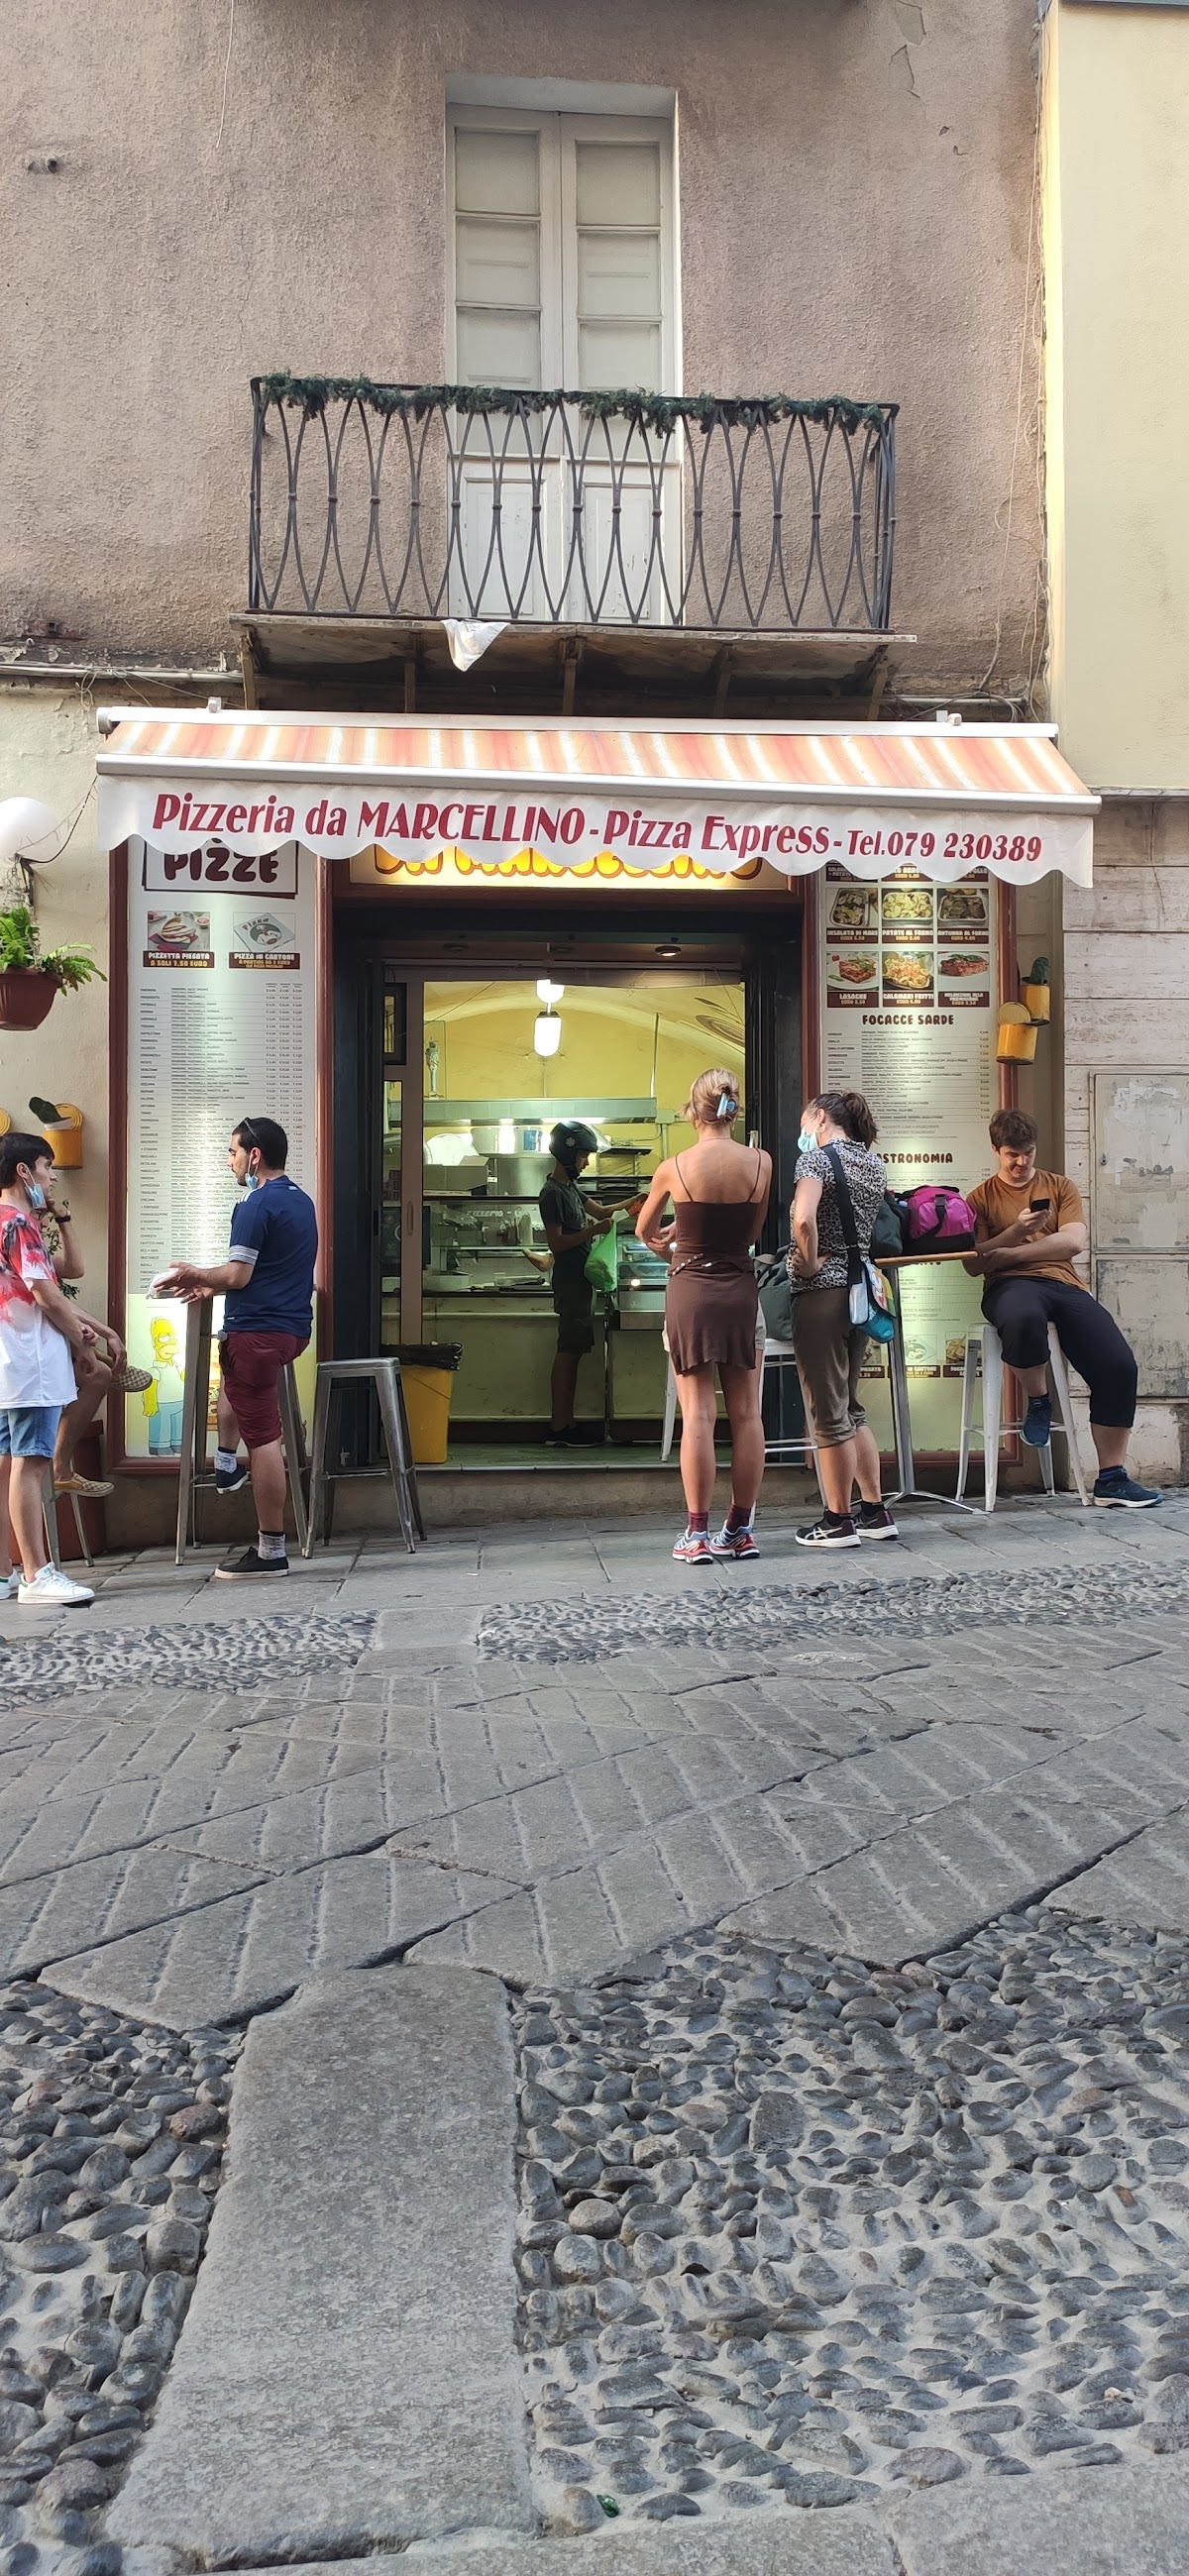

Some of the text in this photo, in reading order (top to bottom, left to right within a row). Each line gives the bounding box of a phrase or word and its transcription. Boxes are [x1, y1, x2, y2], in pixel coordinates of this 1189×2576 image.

[152, 792, 295, 835] Pizzeria
[304, 799, 348, 837] da
[357, 801, 586, 846] MARCELLINO
[602, 808, 694, 849] Pizza
[701, 815, 830, 859] Express
[942, 832, 1043, 863] 230389
[163, 846, 279, 883] PIZZE
[862, 1014, 954, 1024] FOCACCE SARDE
